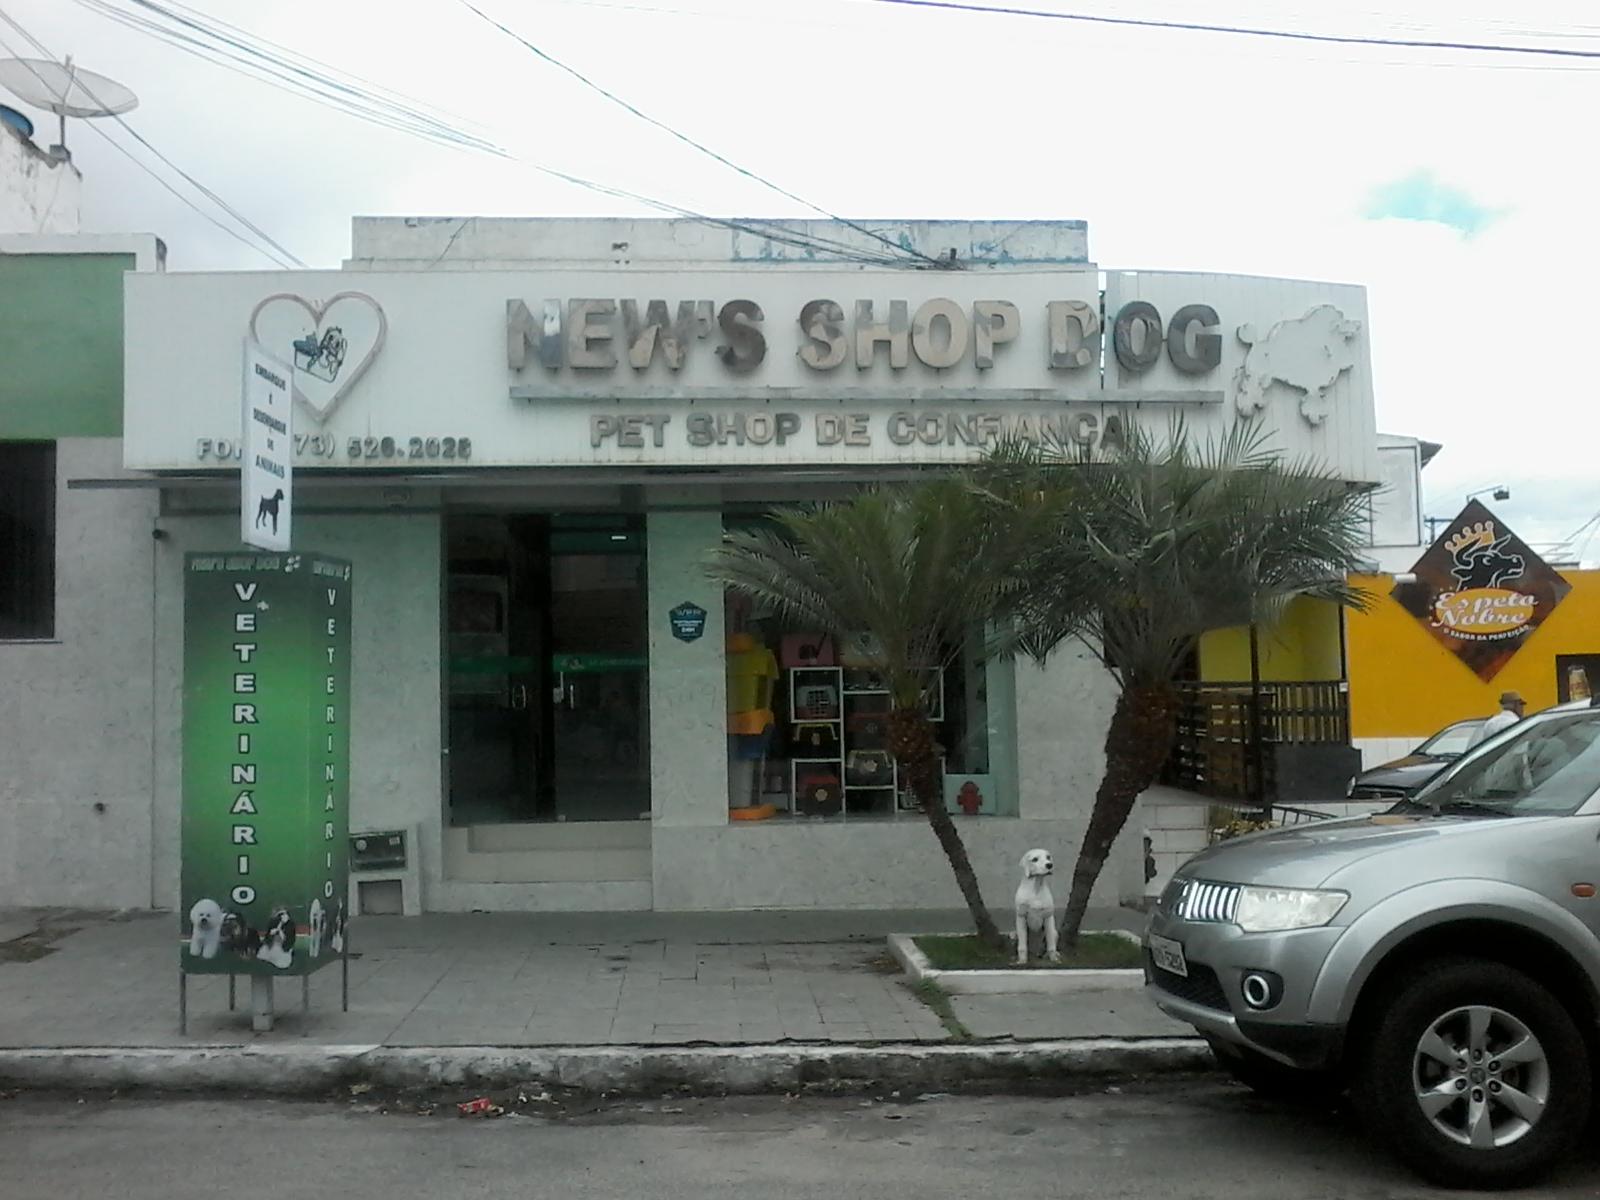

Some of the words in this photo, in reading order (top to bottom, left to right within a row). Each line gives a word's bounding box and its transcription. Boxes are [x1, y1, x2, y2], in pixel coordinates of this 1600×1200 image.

[506, 298, 766, 373] NEW'S
[798, 298, 1021, 371] SHOP
[1047, 299, 1222, 376] DOG
[590, 413, 671, 448] PET
[686, 412, 801, 447] SHOP
[815, 412, 871, 447] DE
[232, 582, 257, 905] VETERINÁRIO
[325, 588, 336, 898] VETERINÁRIO
